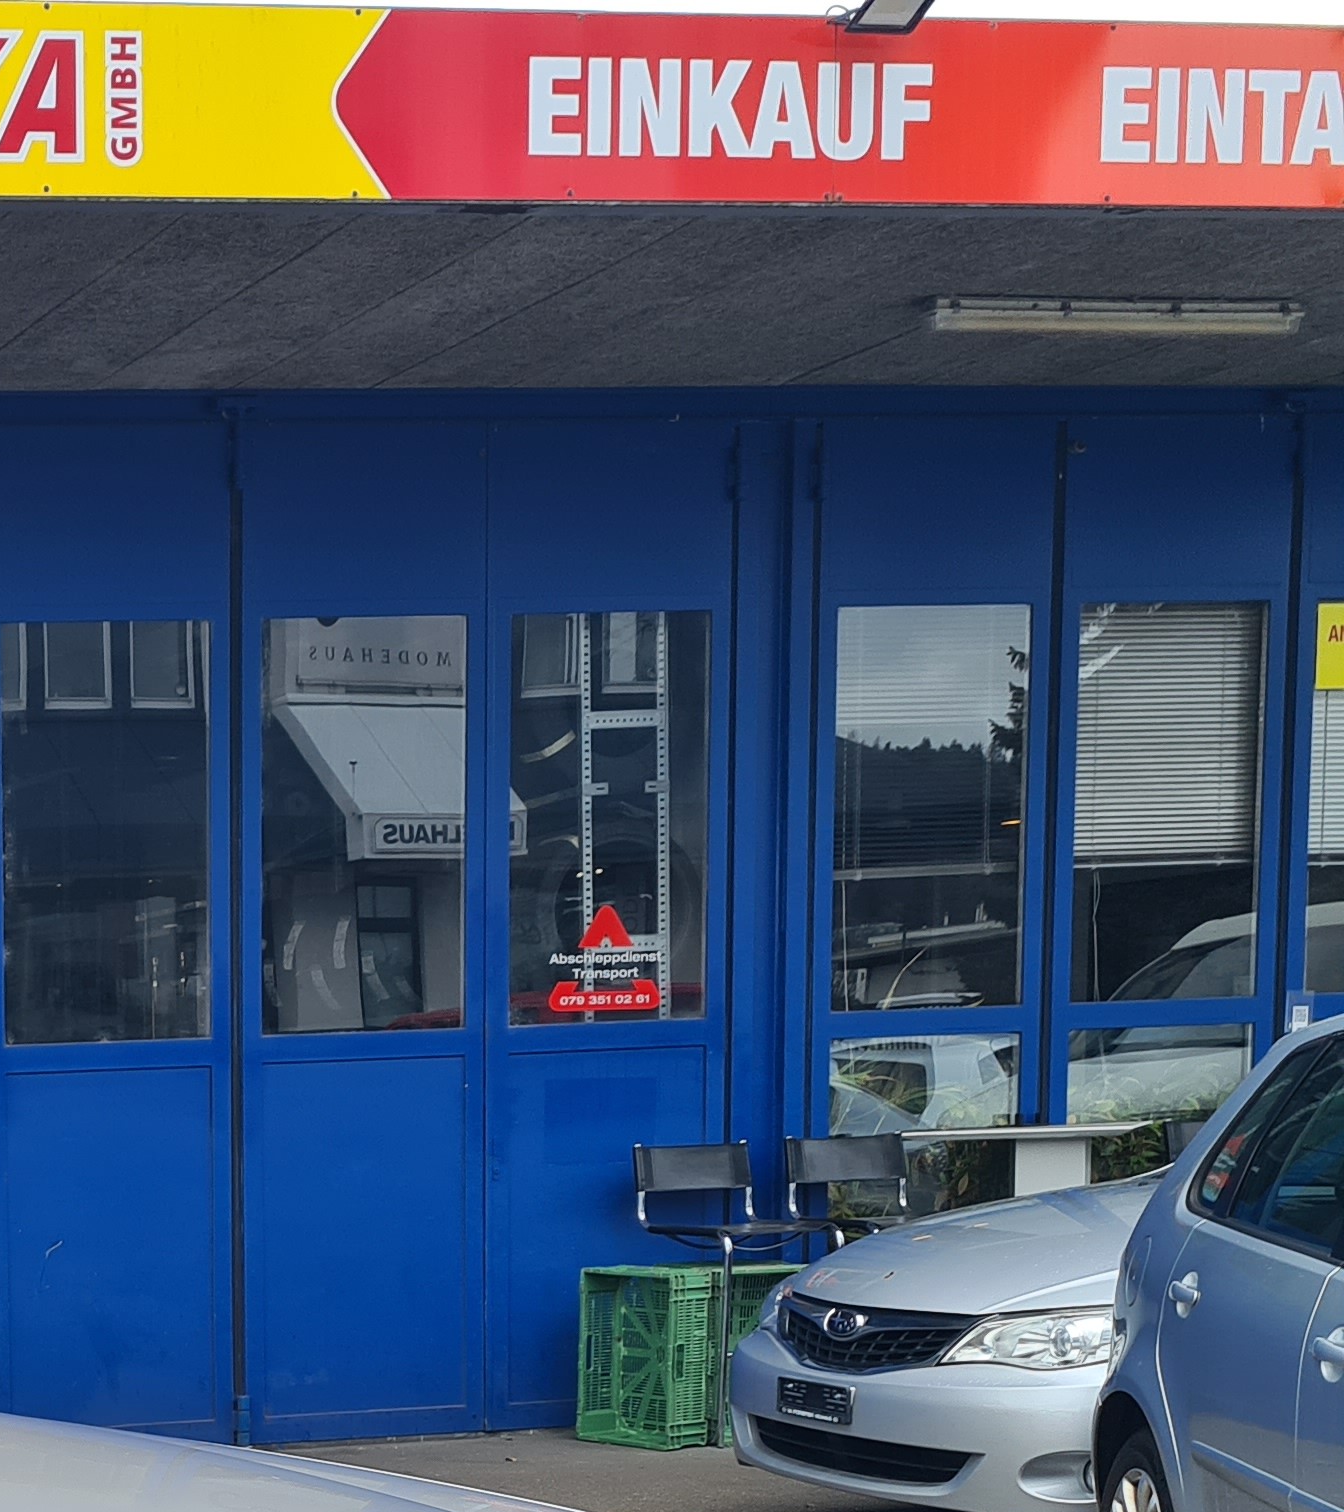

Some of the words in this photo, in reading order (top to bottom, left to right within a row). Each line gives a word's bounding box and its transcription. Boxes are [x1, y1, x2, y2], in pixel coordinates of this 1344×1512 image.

[109, 35, 139, 162] GMBH
[528, 56, 933, 160] EINKAUF
[1100, 66, 1344, 165] EINTA
[549, 951, 662, 965] Abschleppdienst
[572, 967, 639, 981] Transport
[559, 995, 585, 1006] 079
[588, 994, 612, 1005] 351
[615, 994, 633, 1005] 02
